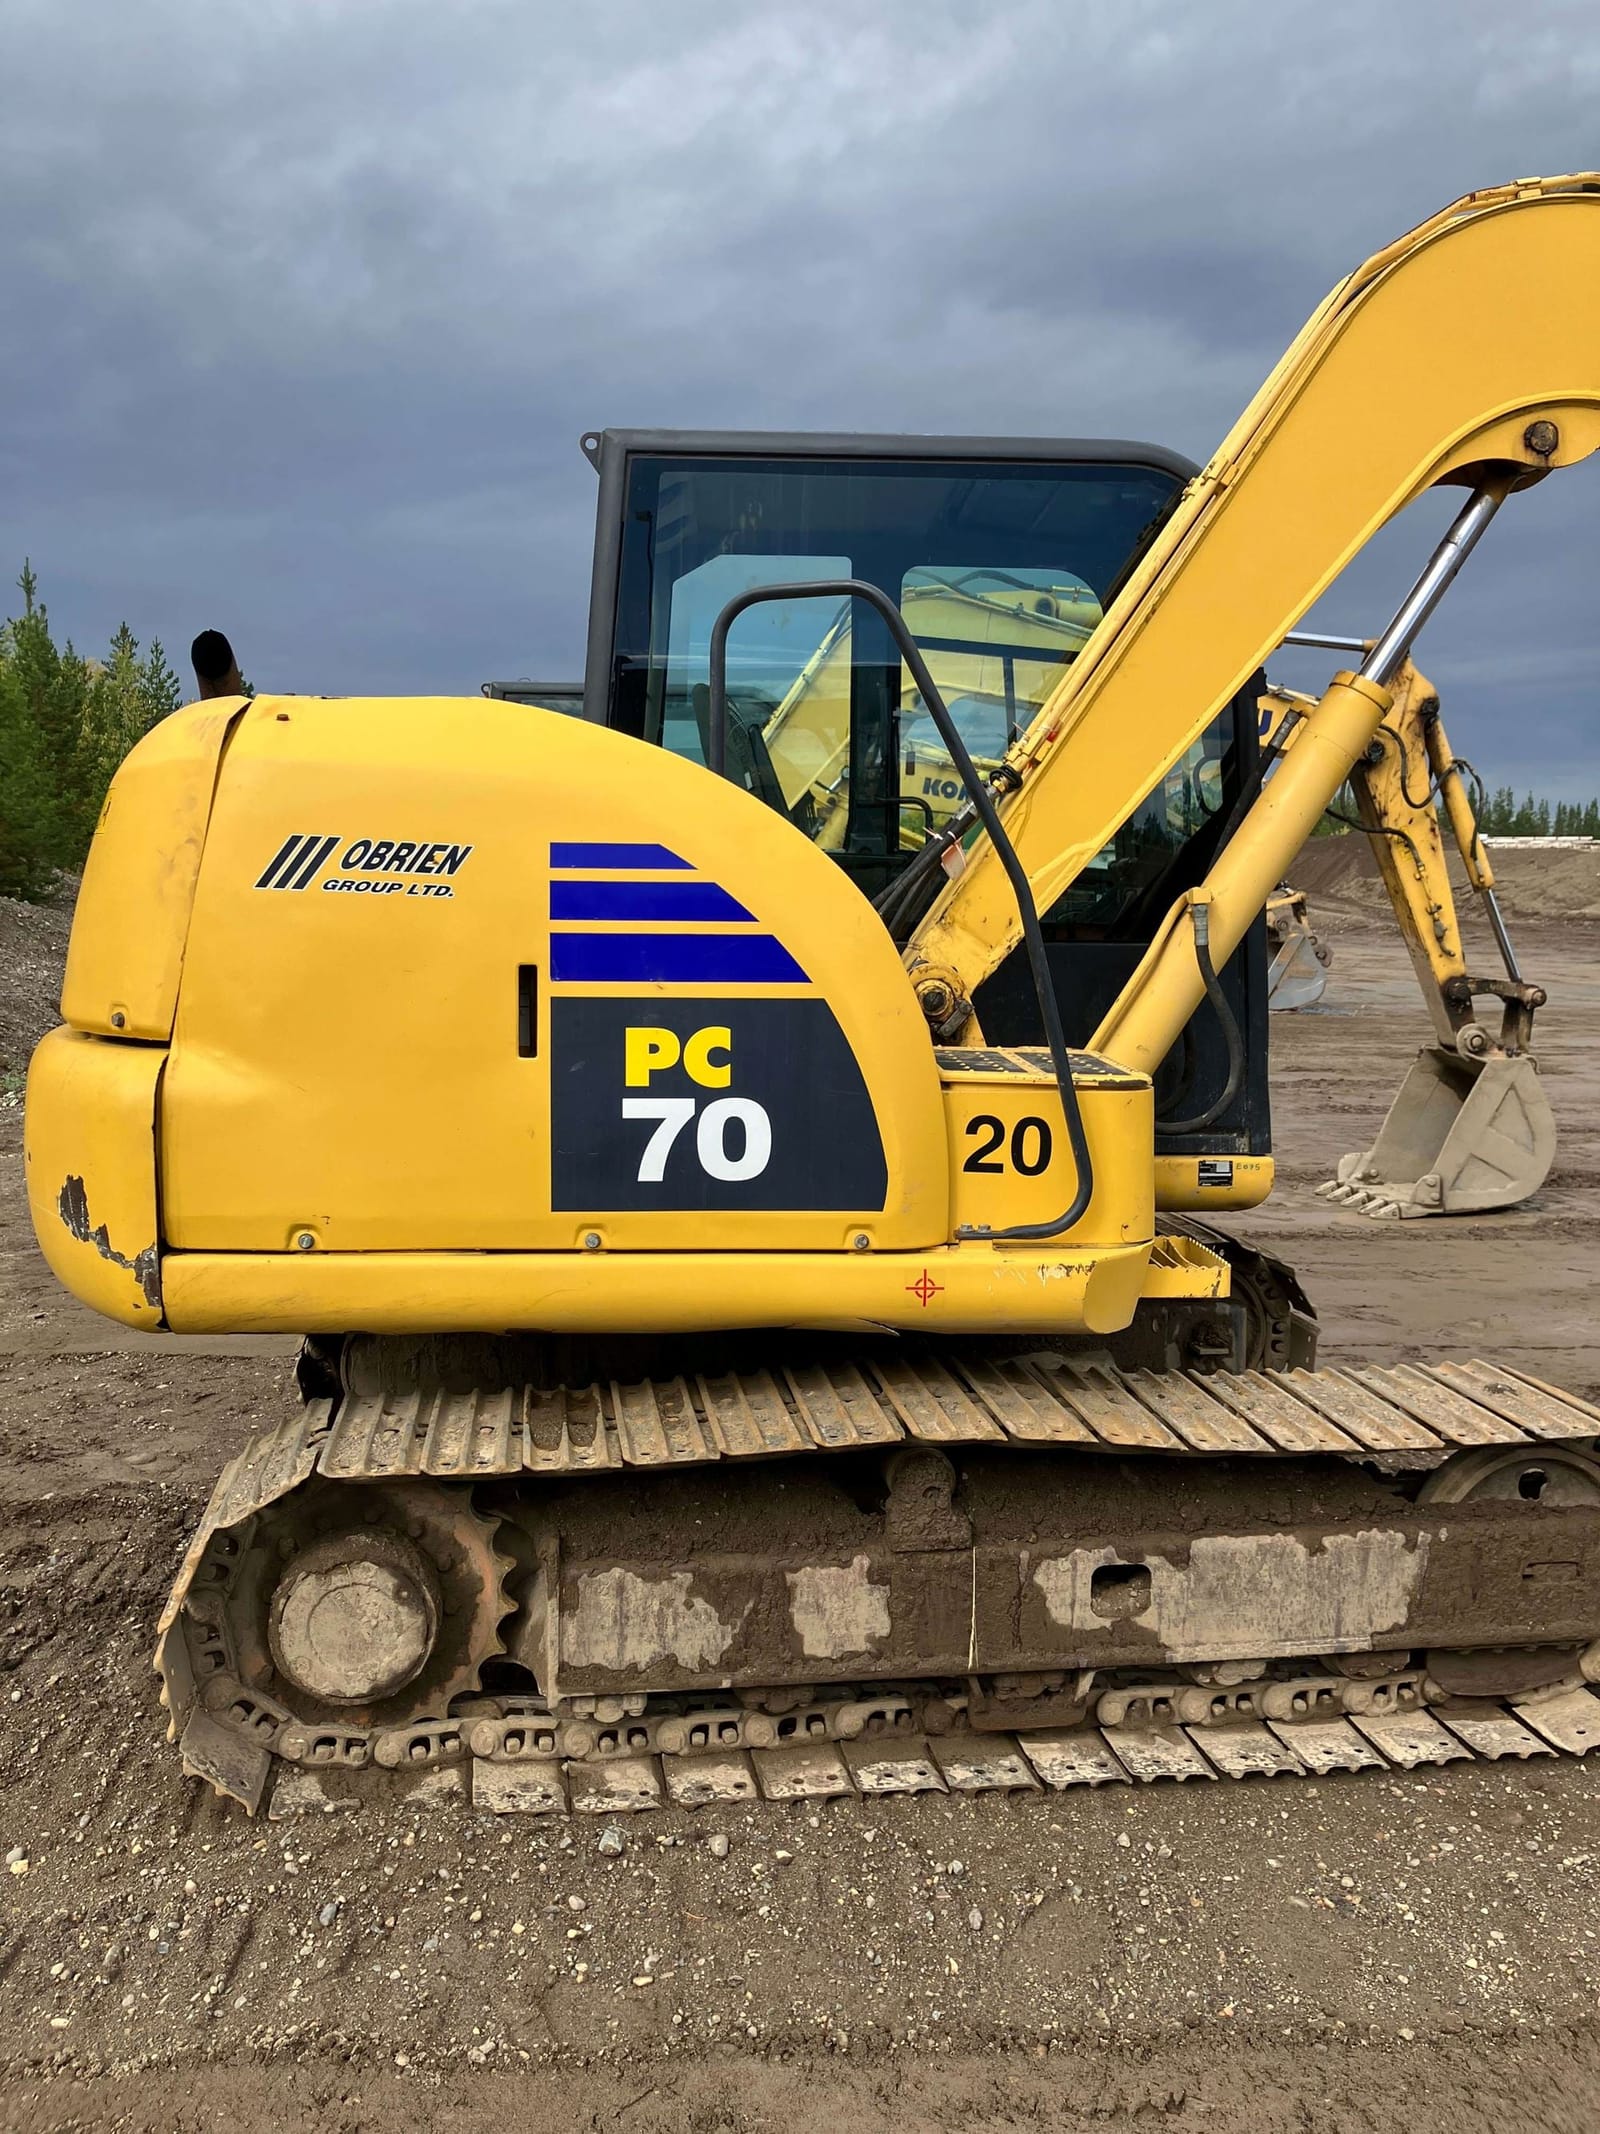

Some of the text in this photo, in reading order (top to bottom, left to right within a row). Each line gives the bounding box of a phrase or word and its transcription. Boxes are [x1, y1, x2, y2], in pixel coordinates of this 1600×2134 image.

[340, 838, 473, 875] OBRIEN
[323, 879, 454, 897] GROUP LTD.
[625, 1026, 732, 1089] PC
[621, 1097, 772, 1182] 70
[963, 1115, 1052, 1176] 20
